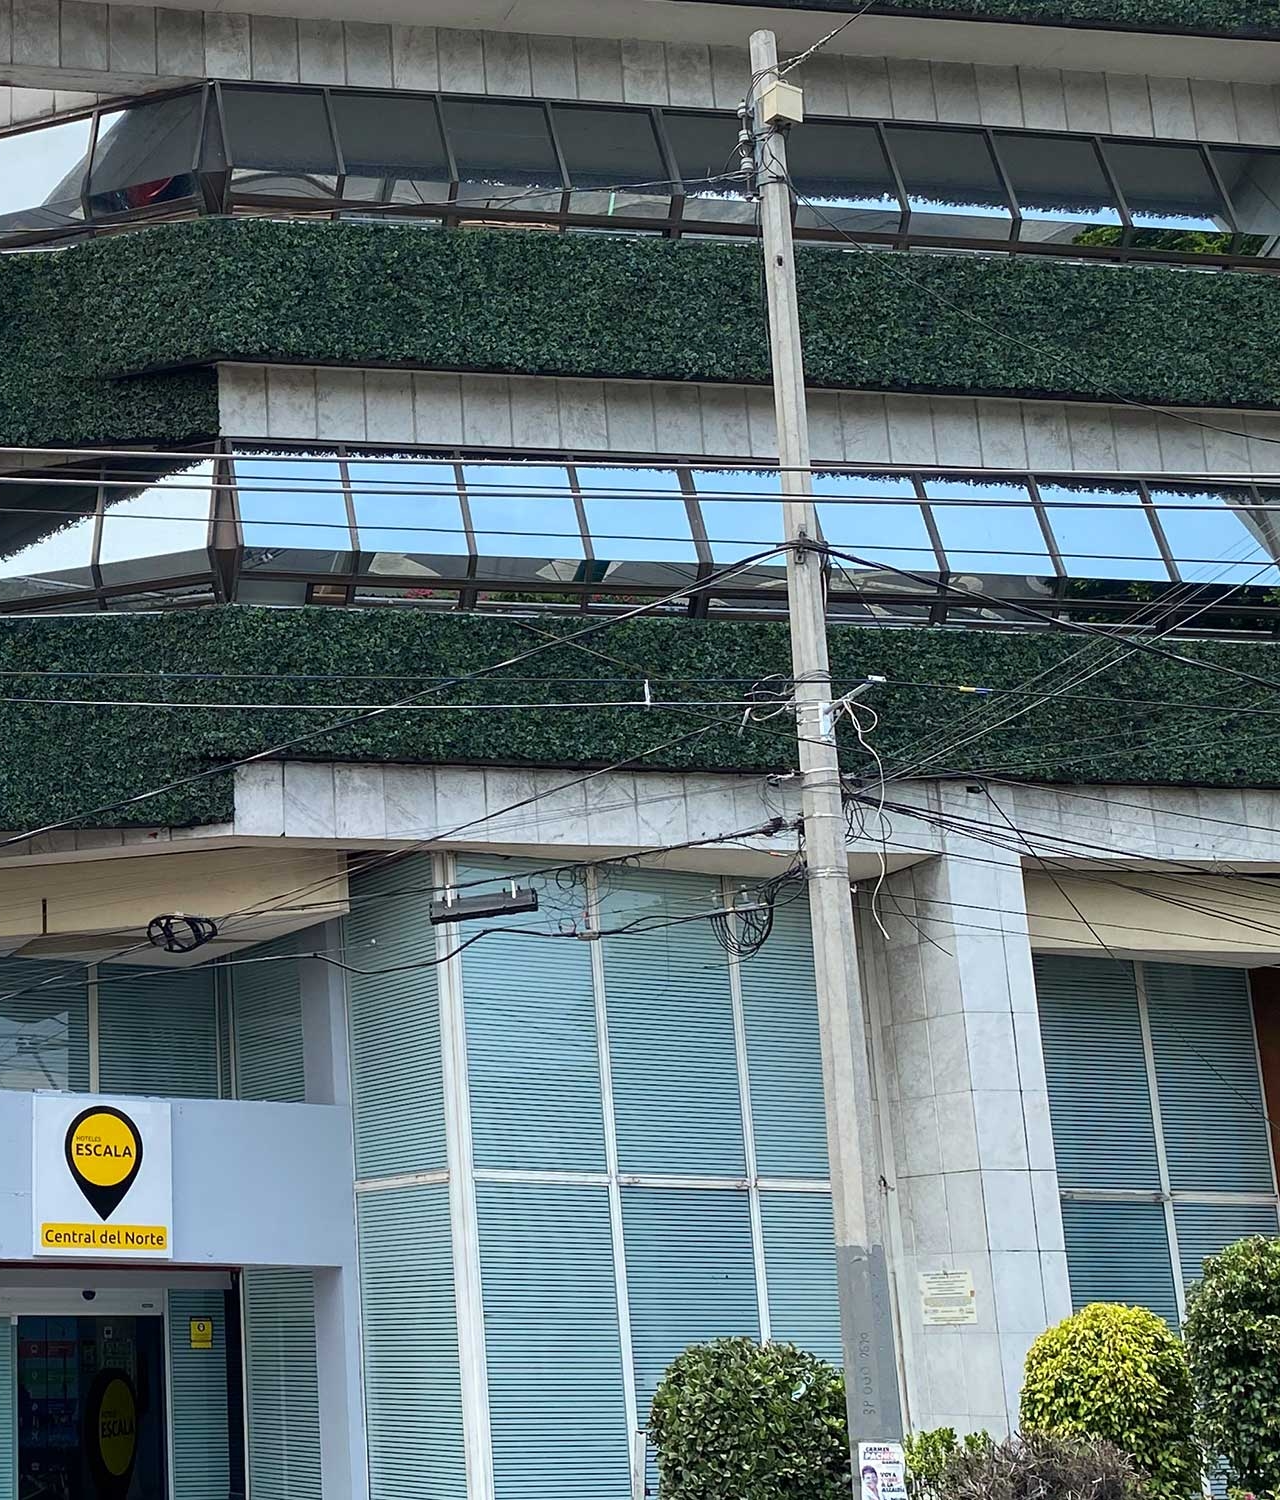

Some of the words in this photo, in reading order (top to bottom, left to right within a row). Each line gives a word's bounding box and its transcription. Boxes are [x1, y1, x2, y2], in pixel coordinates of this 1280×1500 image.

[76, 1143, 133, 1158] ESCALA
[45, 1229, 96, 1244] Central
[100, 1230, 121, 1244] del
[125, 1231, 164, 1245] Norte
